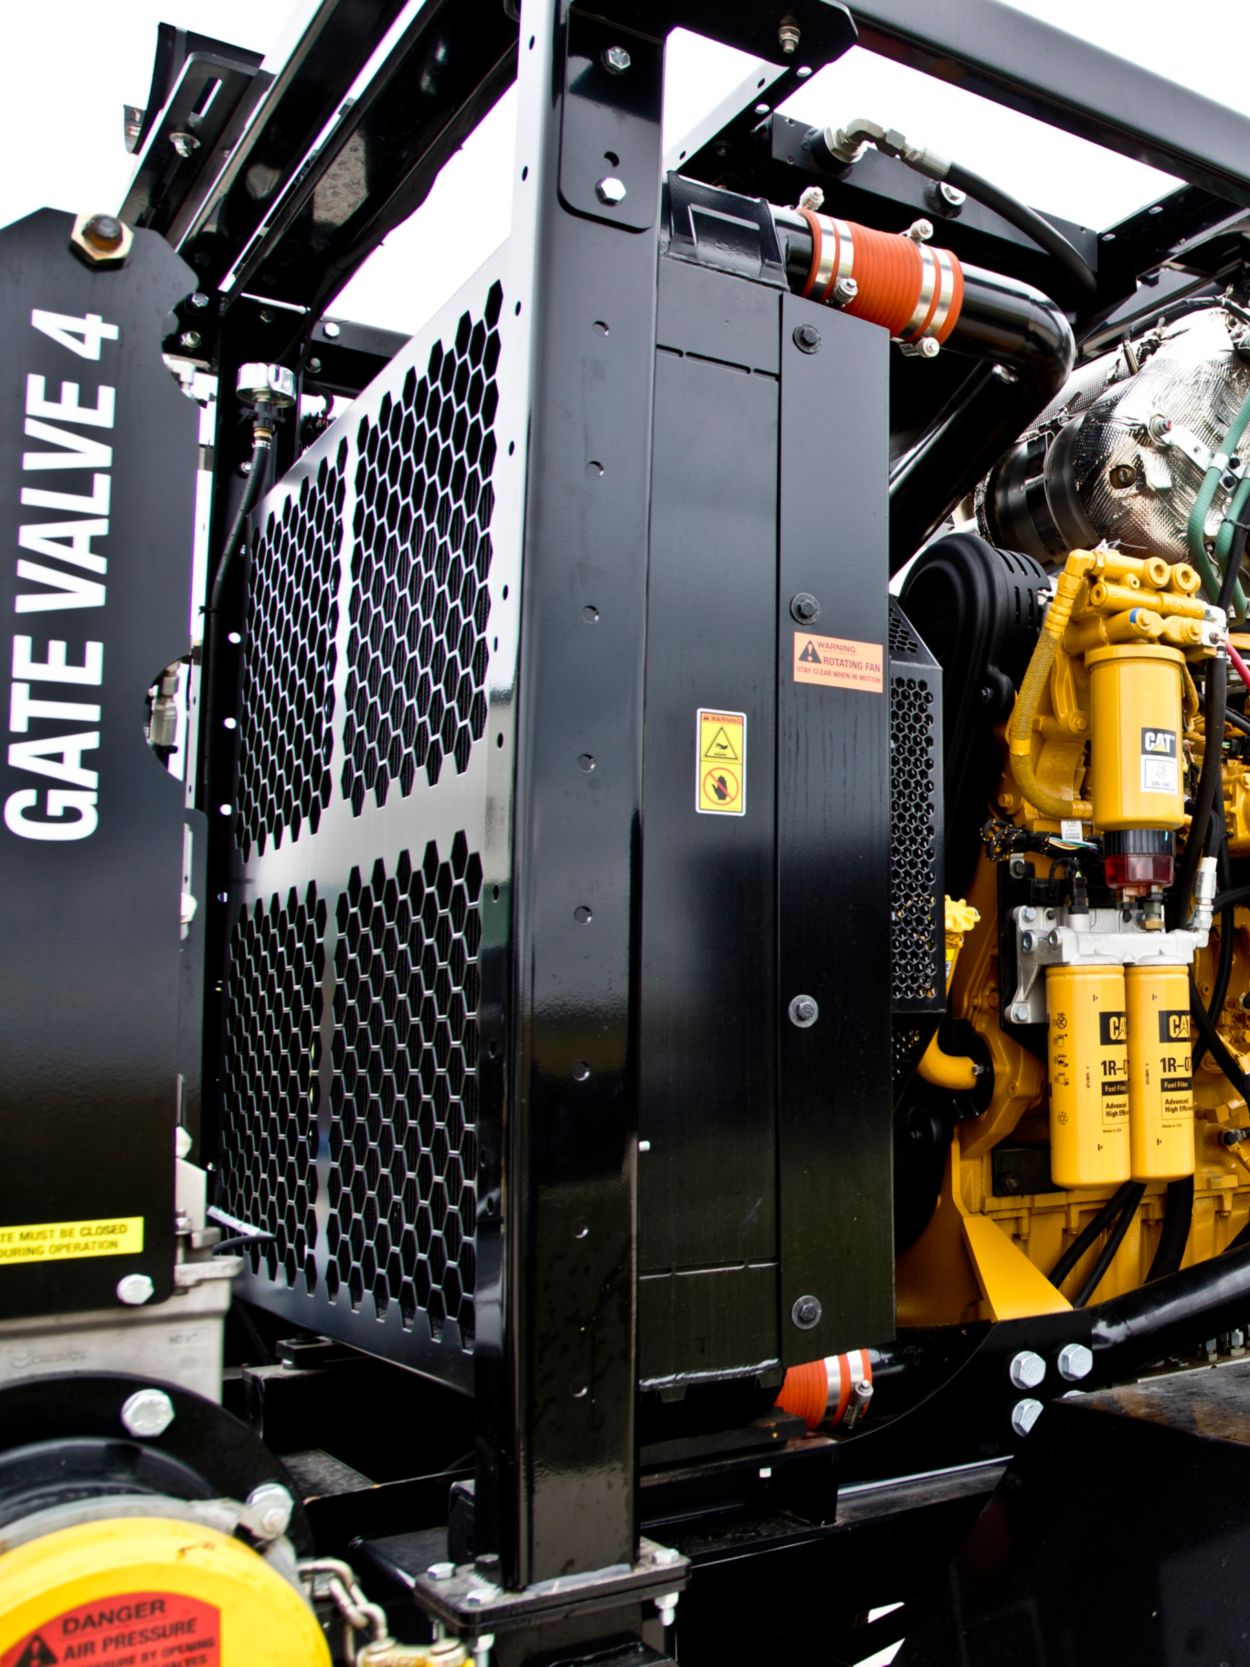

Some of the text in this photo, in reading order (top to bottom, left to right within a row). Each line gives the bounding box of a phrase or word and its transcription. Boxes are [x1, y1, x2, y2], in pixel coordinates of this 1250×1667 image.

[4, 308, 119, 841] GATE VALVE 4
[817, 641, 856, 653] WARNING
[823, 656, 881, 673] ROTATING FAN
[1145, 732, 1170, 753] CAT
[1109, 1016, 1127, 1040] CA
[20, 1229, 56, 1241] MUST
[59, 1227, 75, 1239] BE
[80, 1224, 128, 1238] CLOSED
[49, 1240, 119, 1255] OPERATION
[62, 1599, 166, 1636] DANGER
[63, 1617, 197, 1662] AIR PRESSURE
[161, 1637, 215, 1658] OPENING
